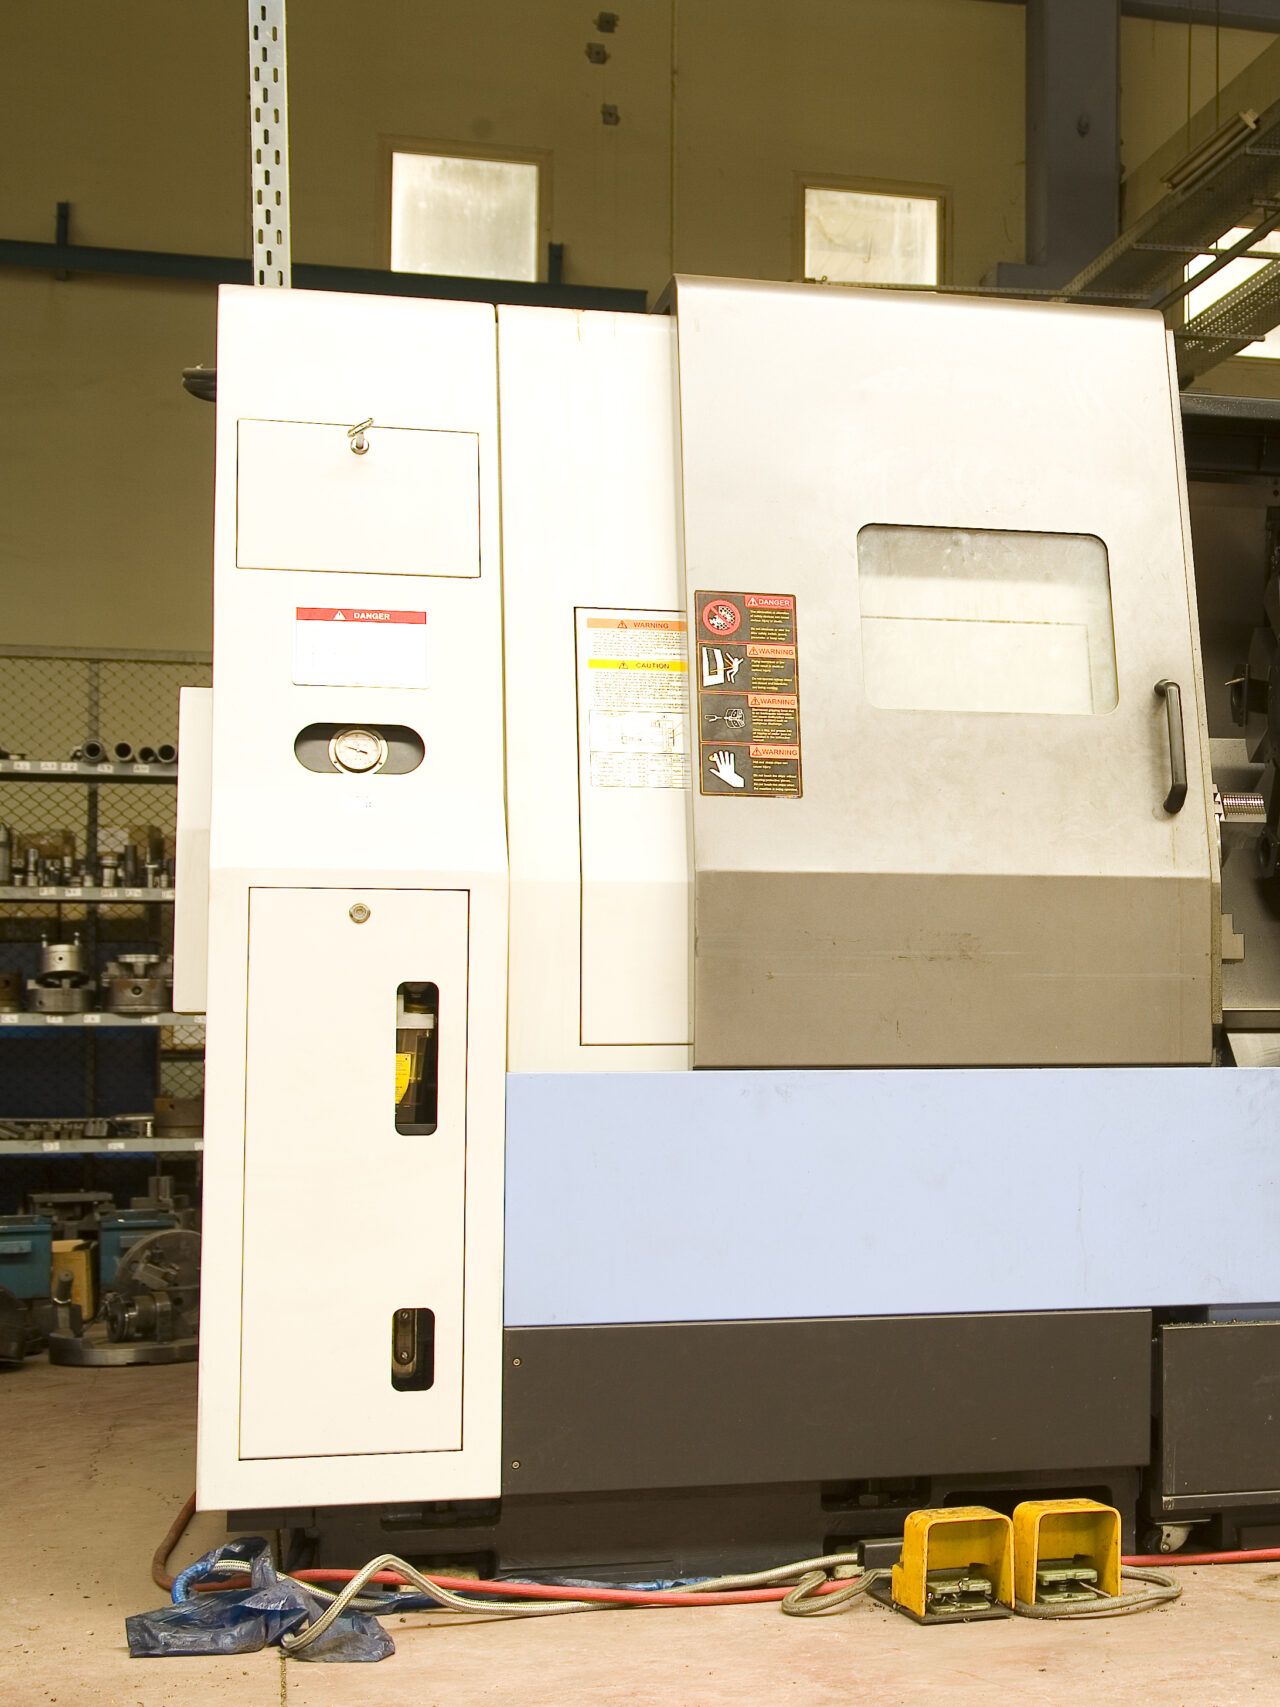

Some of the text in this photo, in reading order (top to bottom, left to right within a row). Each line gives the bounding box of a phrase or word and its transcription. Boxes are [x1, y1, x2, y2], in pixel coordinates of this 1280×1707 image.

[758, 598, 790, 606] DANGER
[354, 612, 390, 620] DANGER
[633, 621, 669, 629] WARNING
[758, 648, 794, 656] WARNING
[636, 662, 670, 670] CAUTION
[760, 698, 796, 706] WARNING
[761, 748, 798, 756] WARNING
